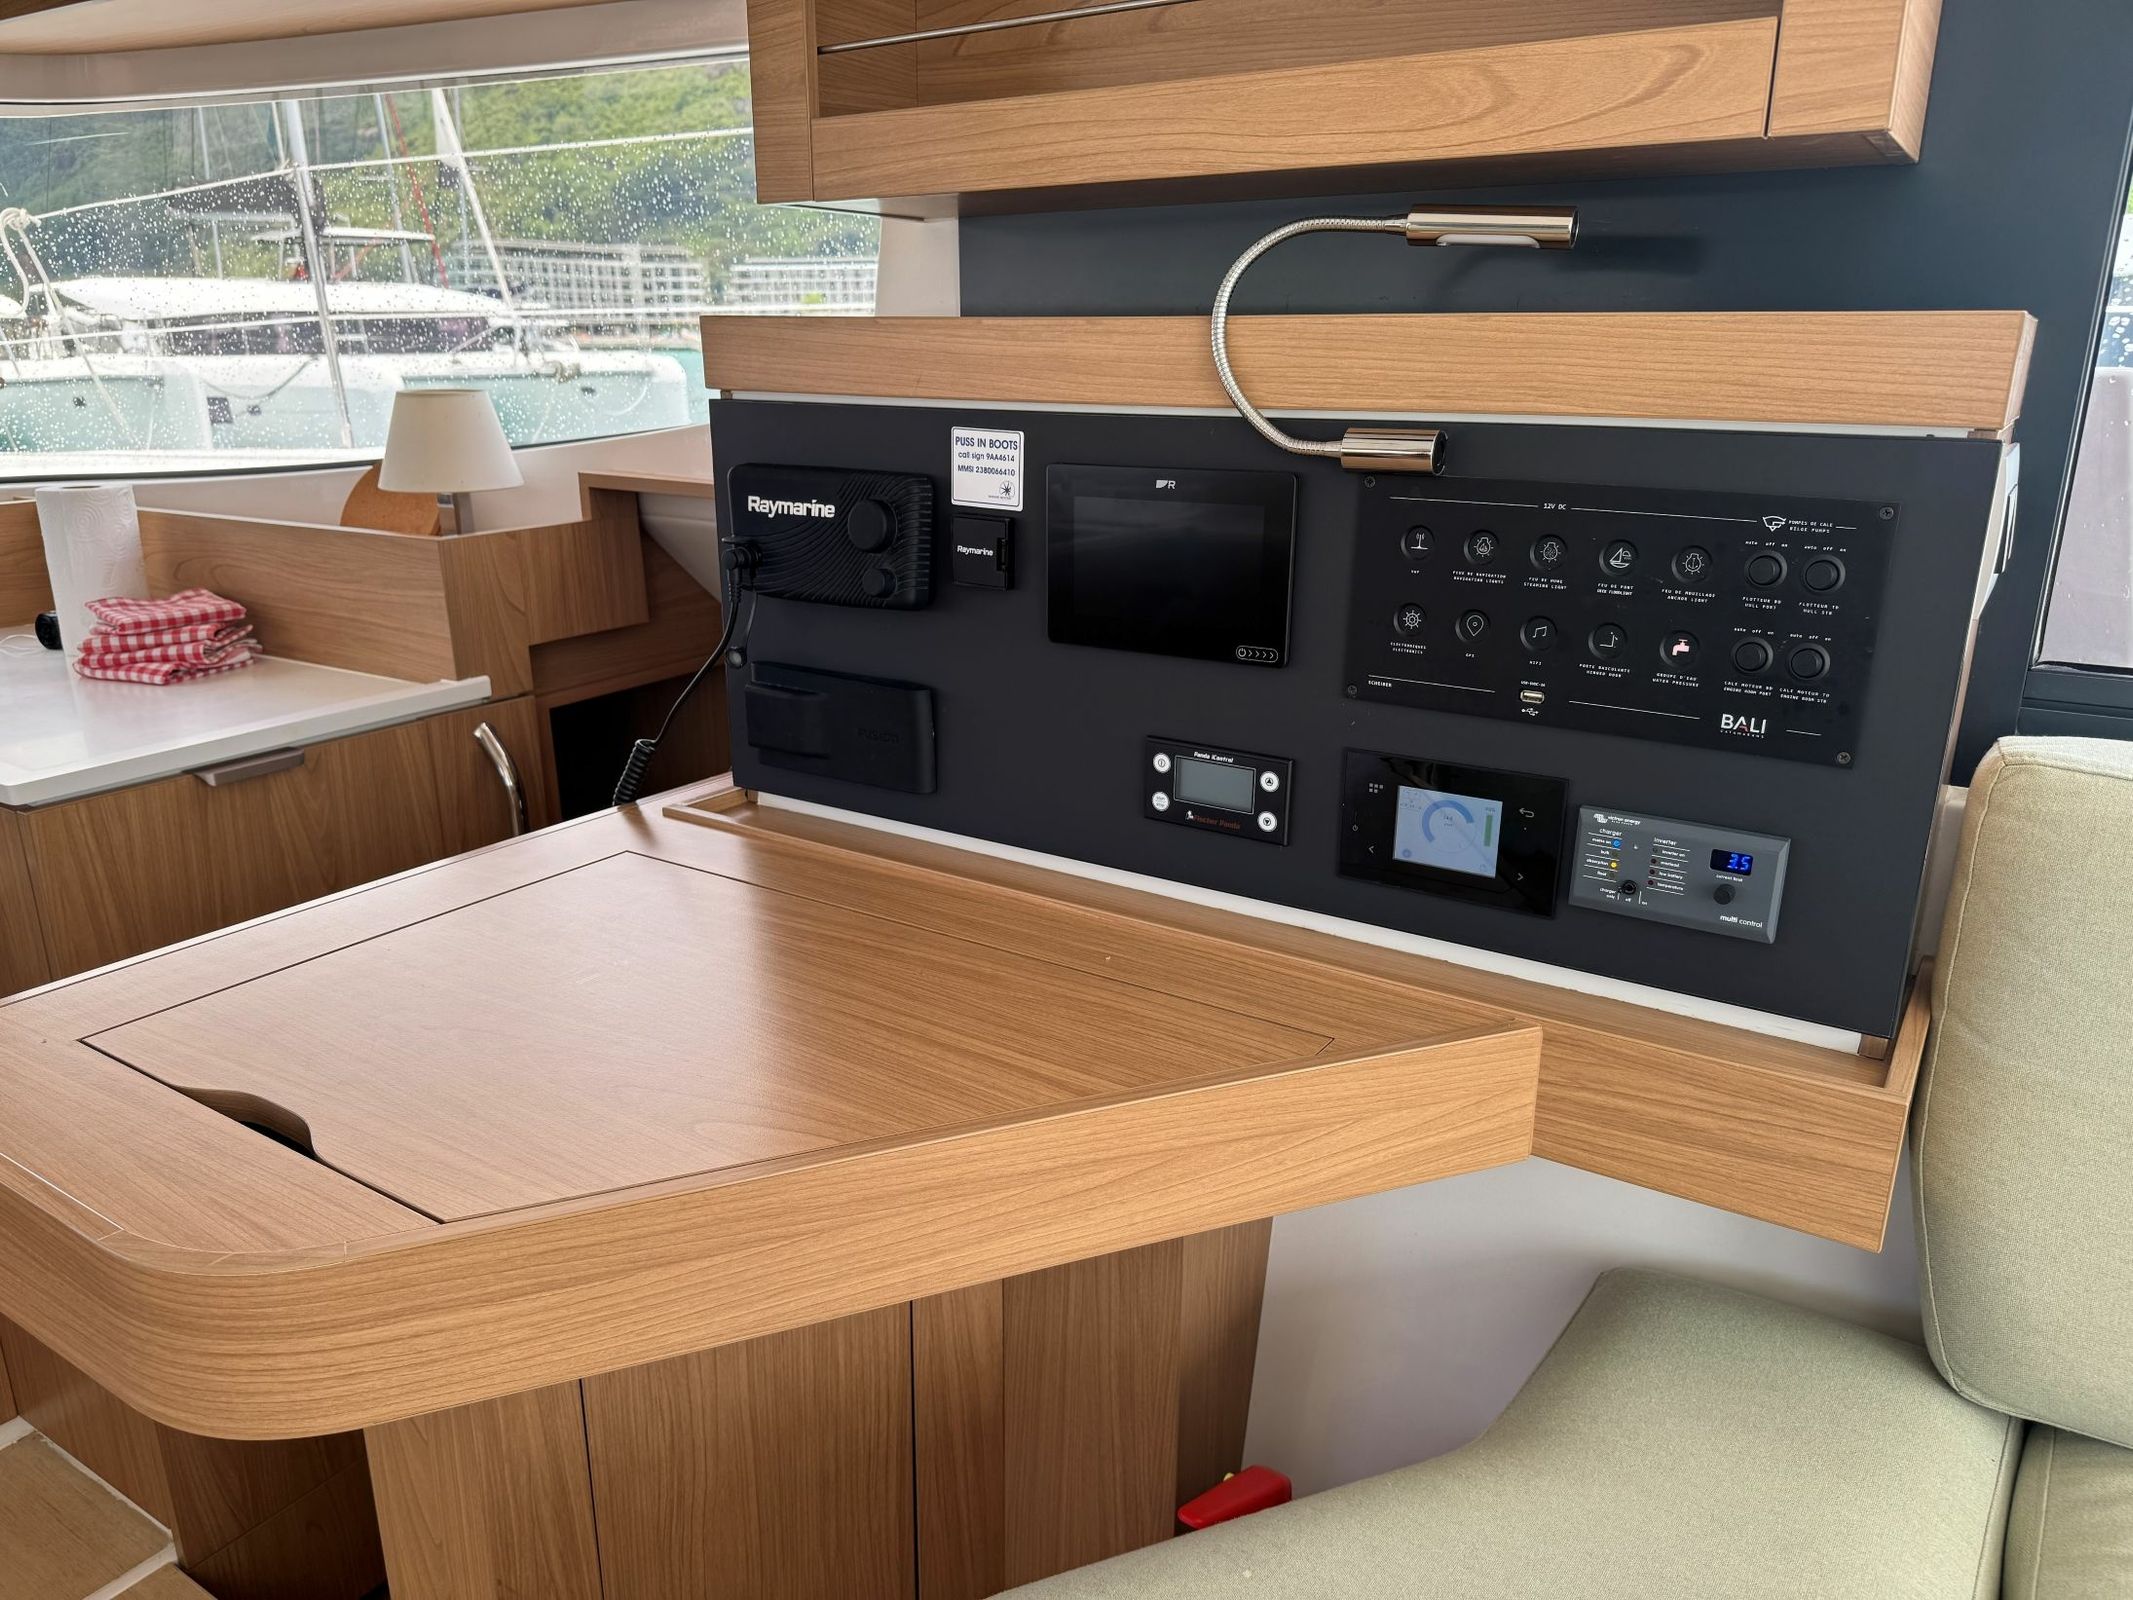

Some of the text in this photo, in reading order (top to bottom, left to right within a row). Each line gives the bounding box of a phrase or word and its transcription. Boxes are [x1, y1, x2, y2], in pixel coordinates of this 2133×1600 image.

[955, 436, 1018, 450] PUSS IN BOOTS
[958, 451, 1015, 462] call sign 9AA4614
[958, 465, 974, 473] MMSI
[747, 495, 836, 518] Raymarine
[957, 545, 994, 557] Raymarine
[1720, 713, 1767, 734] BALI
[1193, 751, 1234, 763] Panda iControl
[1599, 828, 1622, 836] charger
[1654, 837, 1677, 846] inverter
[1720, 915, 1763, 928] multi control
